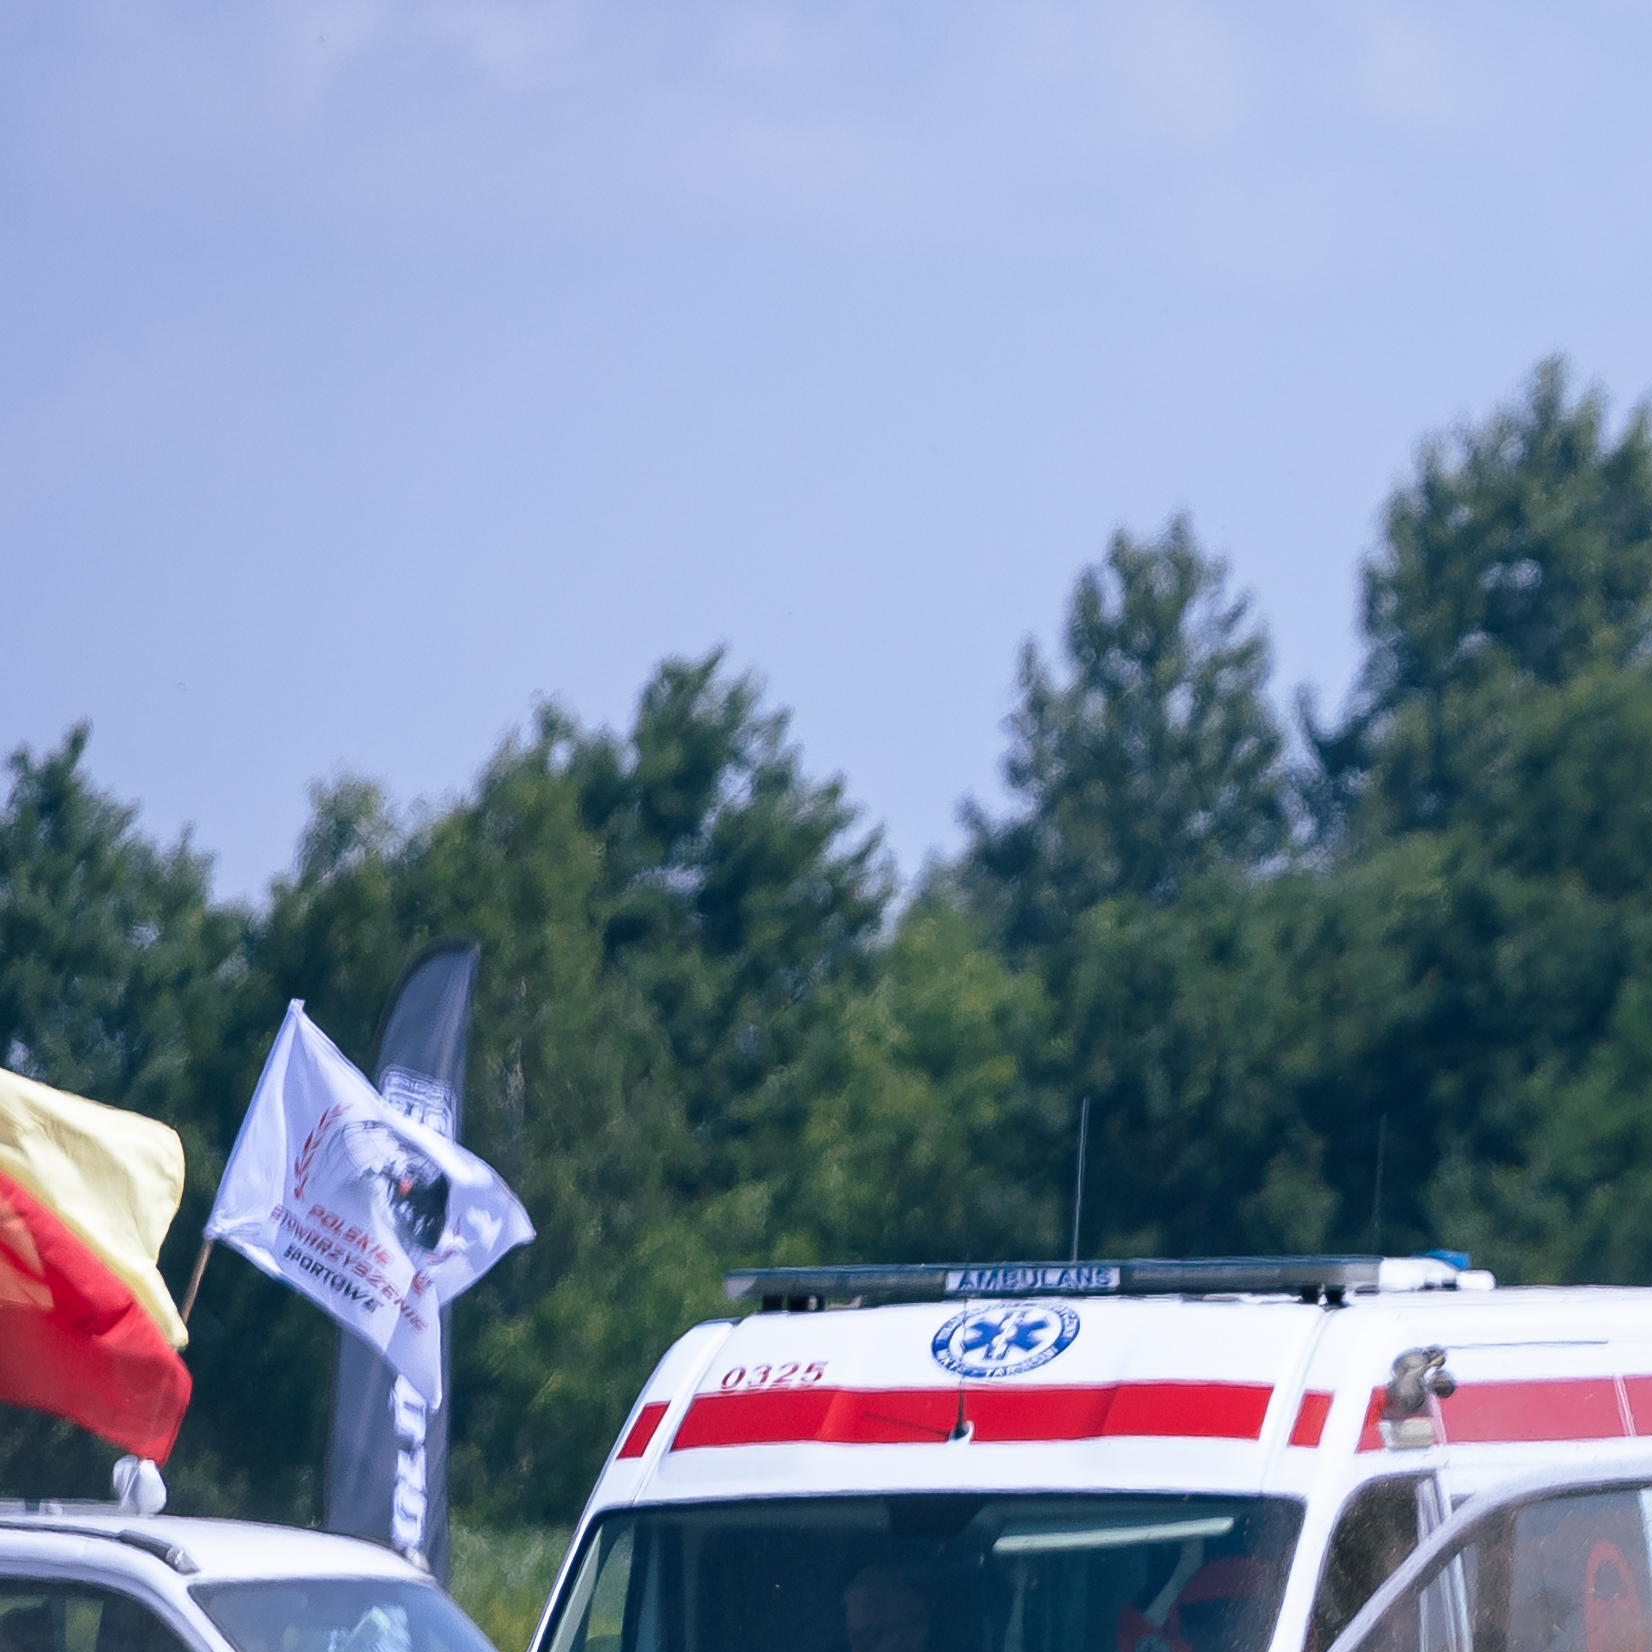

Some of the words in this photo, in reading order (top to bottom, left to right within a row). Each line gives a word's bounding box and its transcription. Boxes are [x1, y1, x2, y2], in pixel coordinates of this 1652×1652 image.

[283, 1244, 385, 1313] SPORTOWE
[957, 1267, 1111, 1291] AMBULANS
[721, 1360, 829, 1390] 0325
